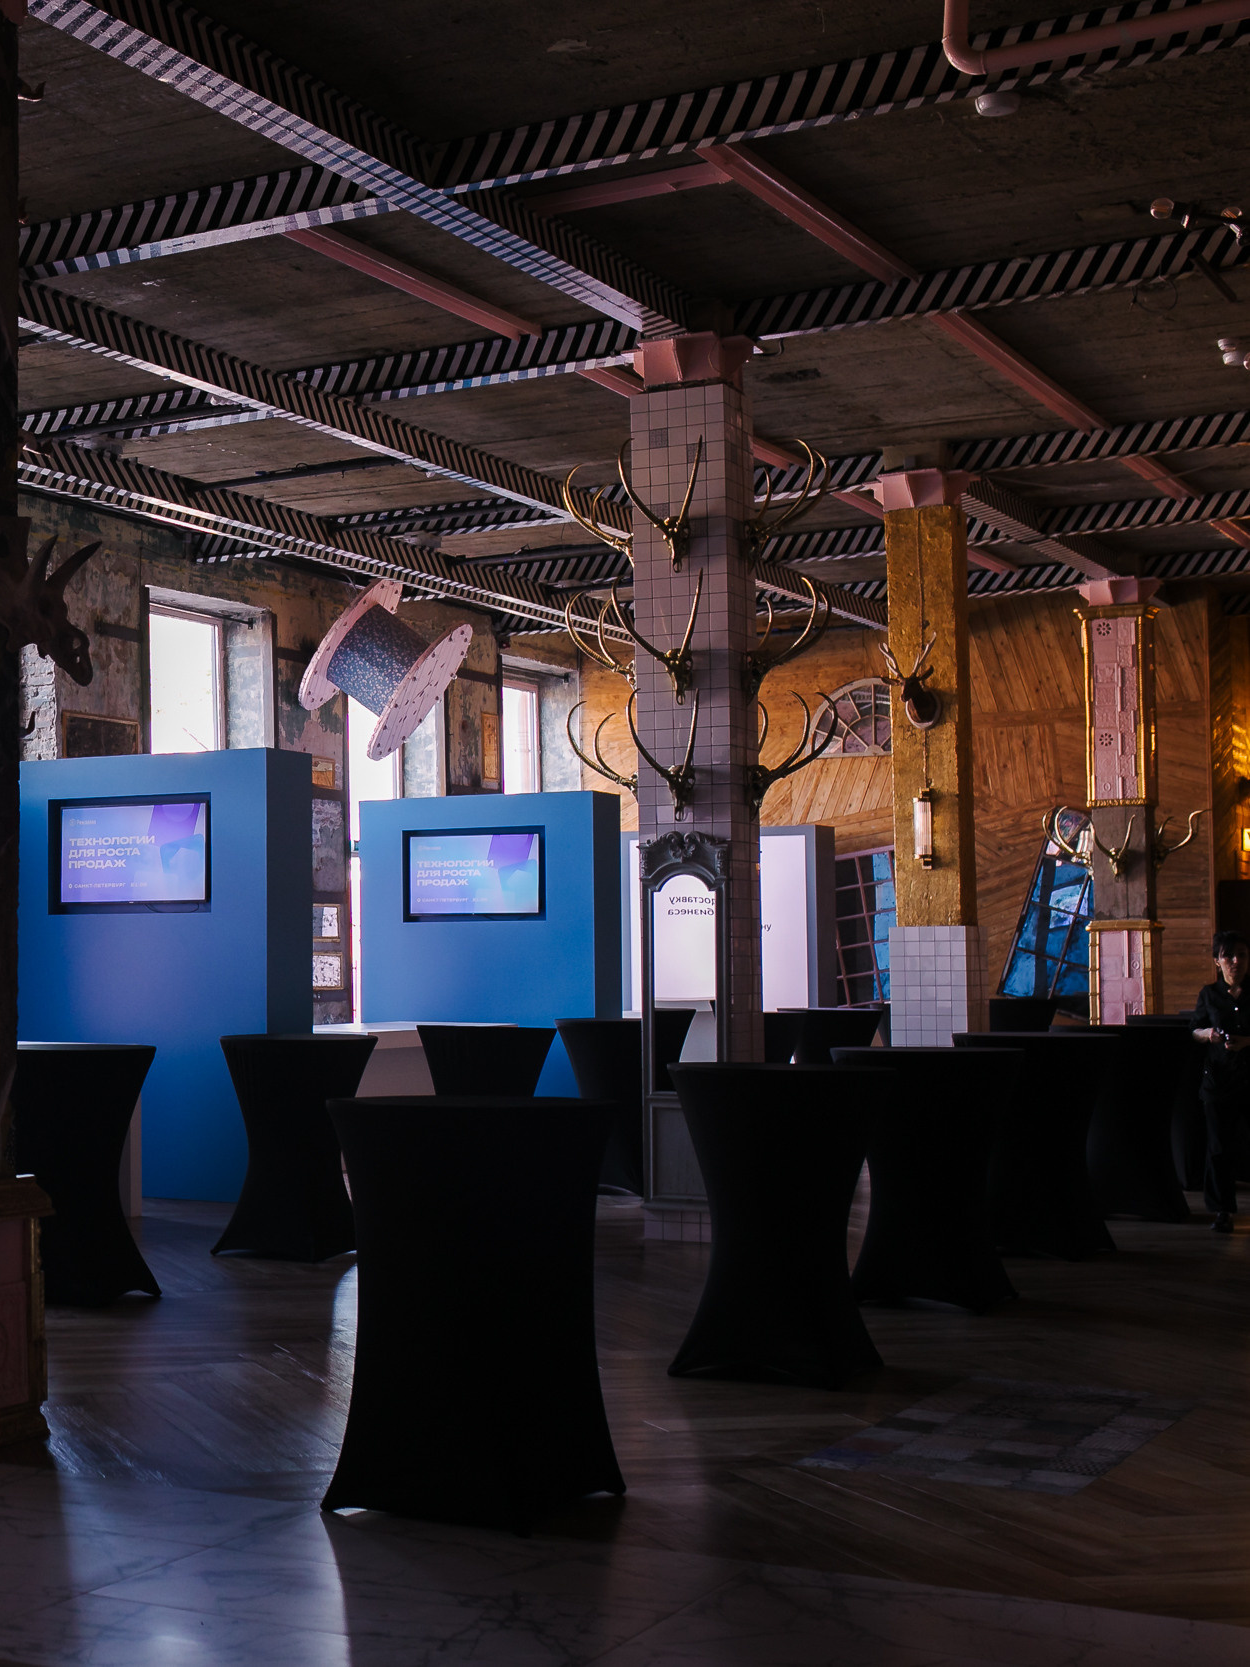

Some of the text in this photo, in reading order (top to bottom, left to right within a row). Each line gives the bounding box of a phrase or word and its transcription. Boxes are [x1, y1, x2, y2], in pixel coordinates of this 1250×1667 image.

[69, 835, 156, 847] ТЕХНОЛОГИИ
[68, 847, 141, 859] ДЛЯ РОСТА
[68, 859, 126, 870] ПРОДАЖ
[417, 859, 494, 868] ТЕХНОЛОГИИ
[417, 869, 482, 878] ДЛЯ РОСТА
[417, 878, 469, 887] ПРОДАЖ
